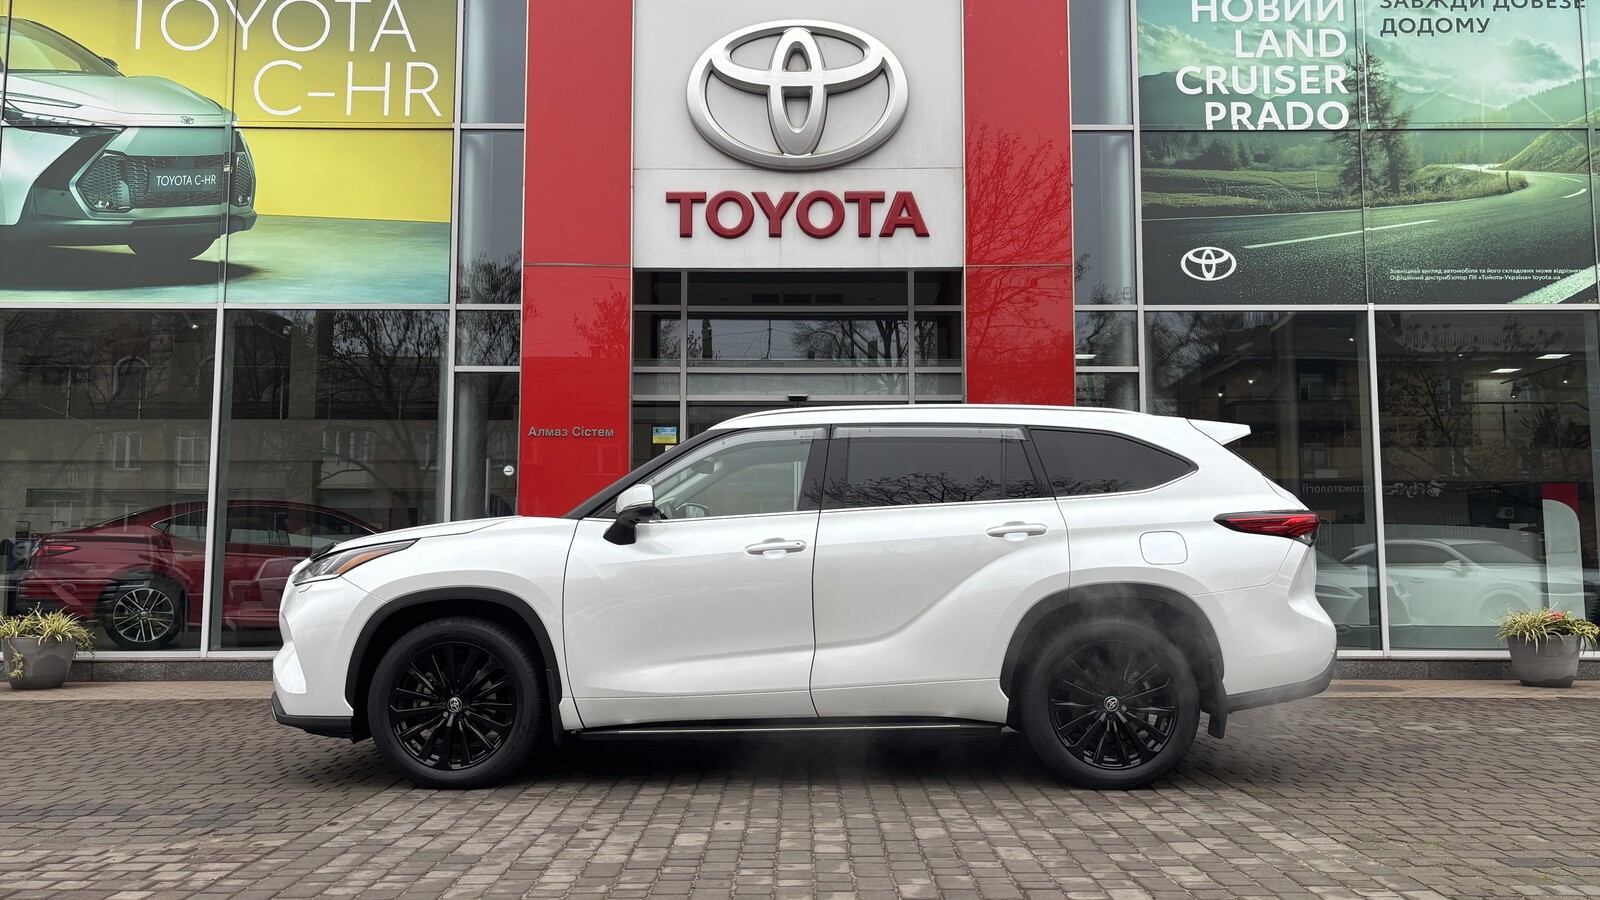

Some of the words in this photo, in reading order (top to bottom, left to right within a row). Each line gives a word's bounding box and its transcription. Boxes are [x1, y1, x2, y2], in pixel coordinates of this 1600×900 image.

[134, 0, 417, 52] TOYOTA
[1380, 17, 1490, 37] ДОДОМУ
[1234, 28, 1347, 58] LAND
[252, 59, 442, 117] C-HR
[1175, 64, 1349, 95] CRUISER
[1204, 101, 1350, 131] PRADO
[156, 175, 193, 187] TOYOTA
[194, 174, 217, 186] C-HR
[665, 189, 931, 240] TOYOTA
[527, 426, 568, 437] Алмаз
[571, 426, 615, 437] Сістем
